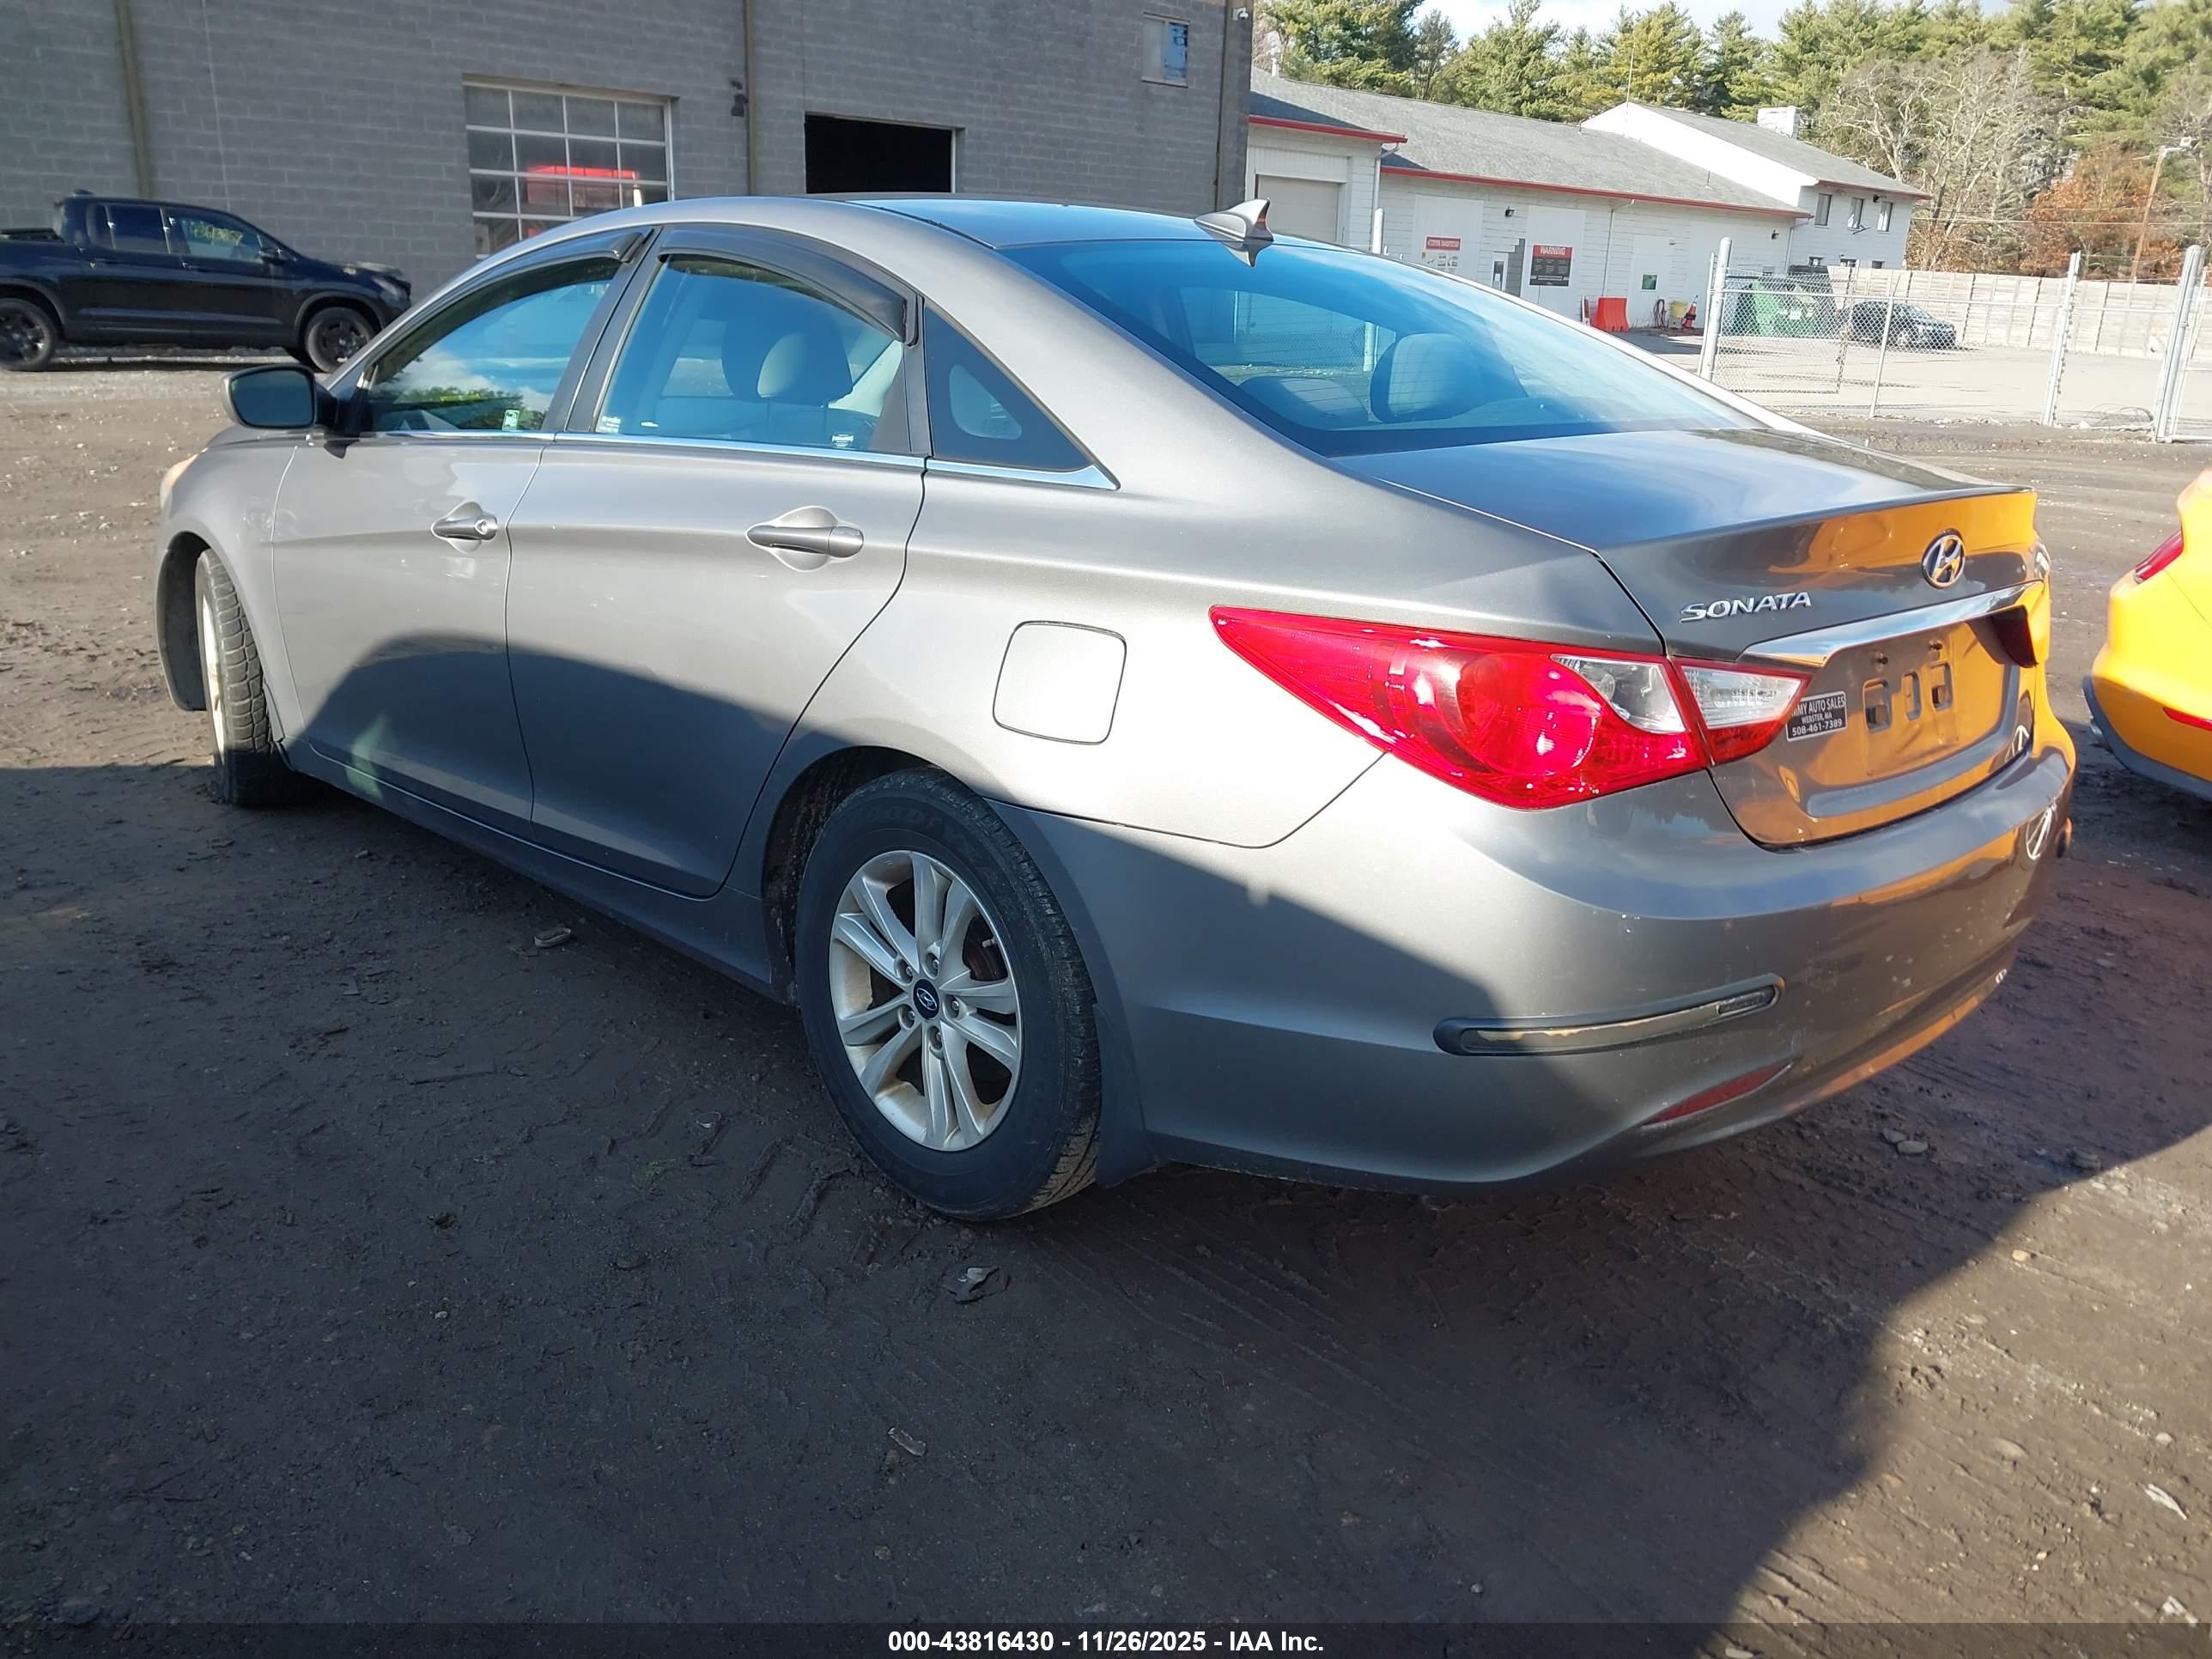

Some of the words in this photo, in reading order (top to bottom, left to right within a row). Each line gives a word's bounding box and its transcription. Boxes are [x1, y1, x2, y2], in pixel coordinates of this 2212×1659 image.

[1540, 246, 1565, 256] WARNING
[1679, 592, 1813, 624] SONATA
[1808, 699, 1826, 714] AUTO
[1826, 696, 1845, 710] SALES
[1825, 711, 1833, 720] MA
[1791, 718, 1843, 737] 508-461-7389
